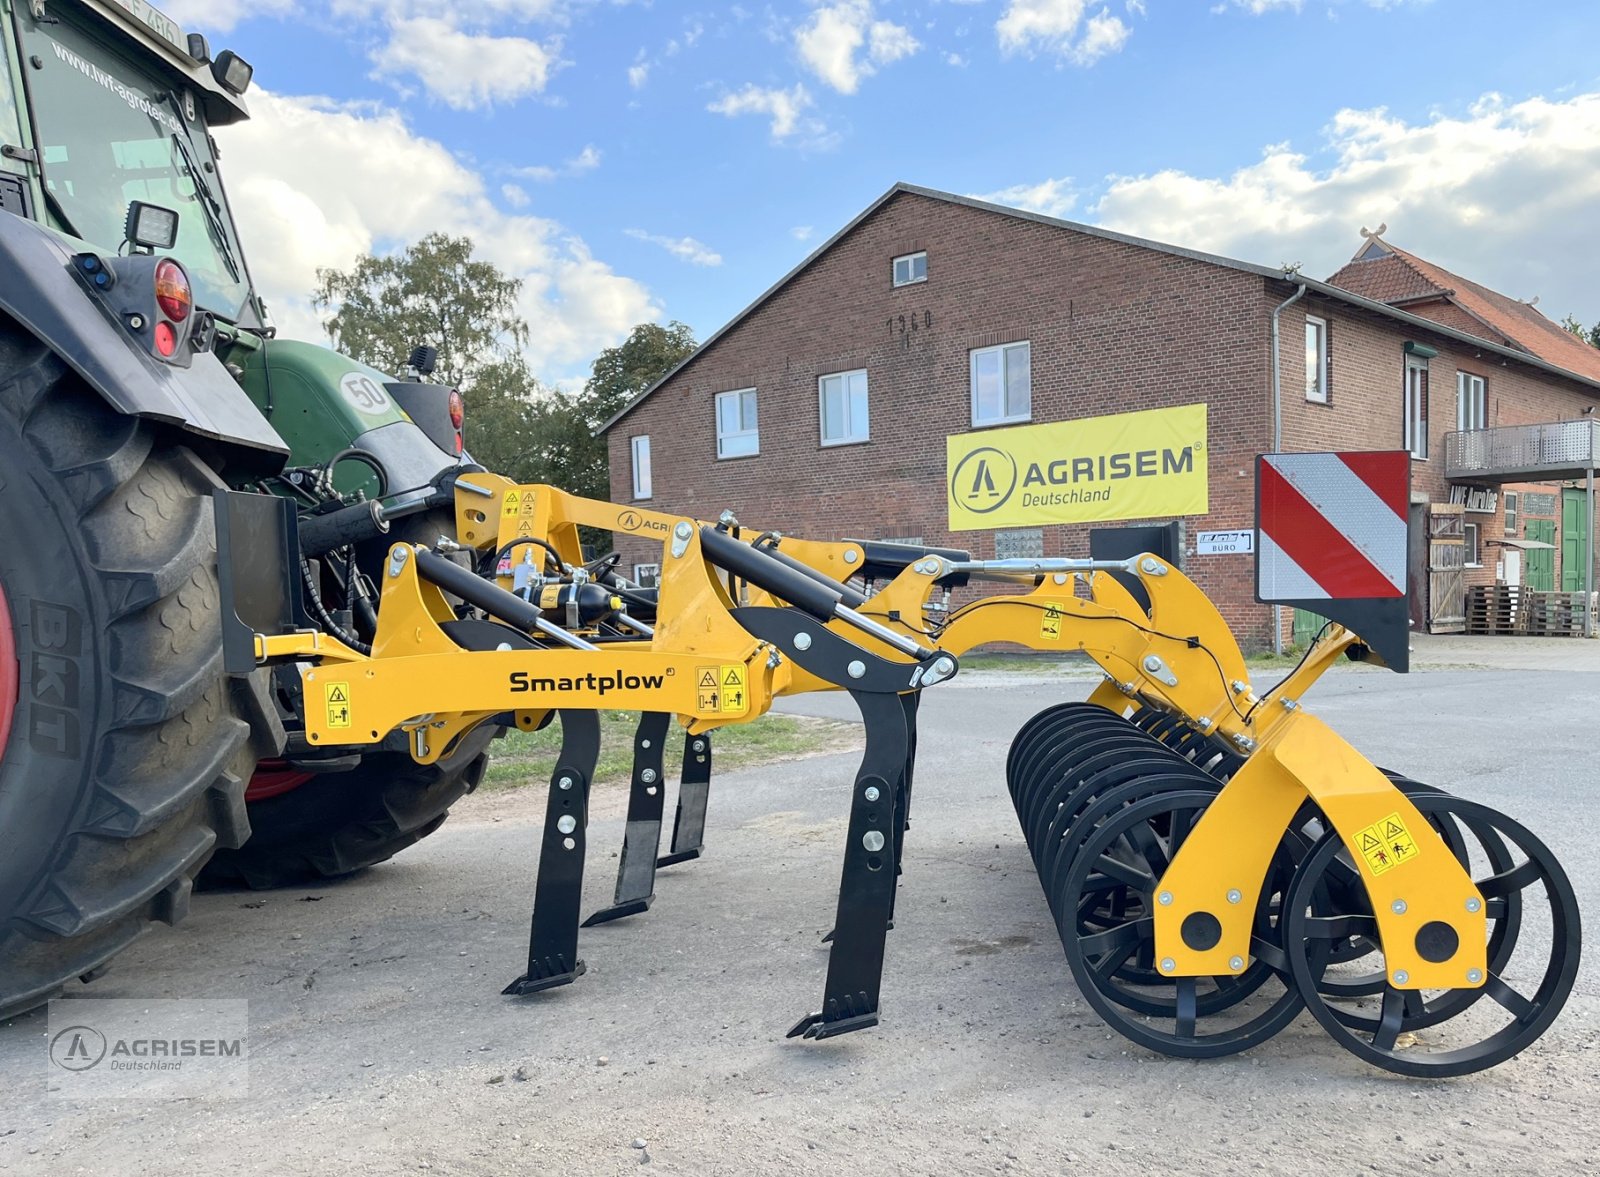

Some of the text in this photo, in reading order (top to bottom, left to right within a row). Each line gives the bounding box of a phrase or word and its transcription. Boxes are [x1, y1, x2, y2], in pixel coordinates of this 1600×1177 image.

[52, 42, 184, 136] www.lwf-agrotec.de
[886, 309, 931, 336] 1960
[345, 378, 386, 408] 50
[1022, 446, 1193, 487] AGRISEM
[1022, 486, 1111, 507] Deutschland
[36, 607, 69, 753] BKT
[510, 669, 663, 695] Smartplow
